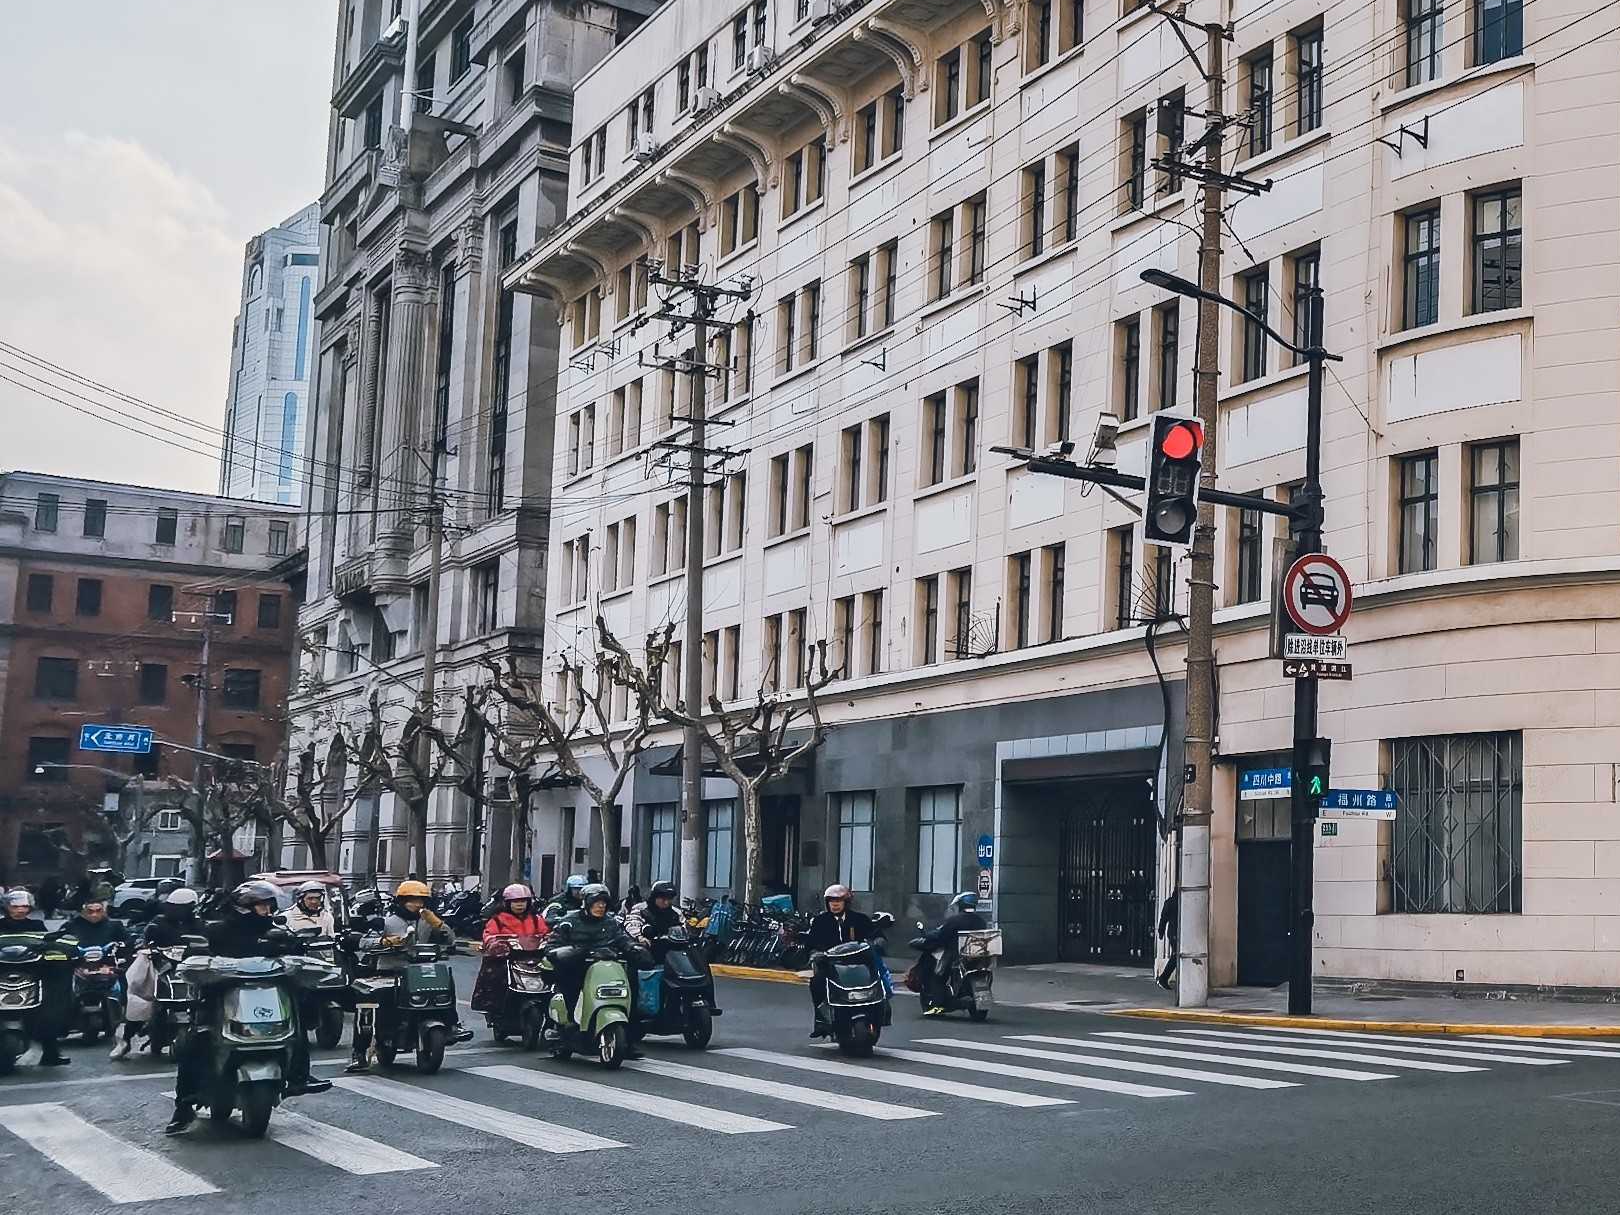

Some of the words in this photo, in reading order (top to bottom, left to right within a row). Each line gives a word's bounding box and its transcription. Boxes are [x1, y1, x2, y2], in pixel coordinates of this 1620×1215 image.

[1338, 793, 1377, 807] 福州路
[978, 844, 992, 857] 出口
